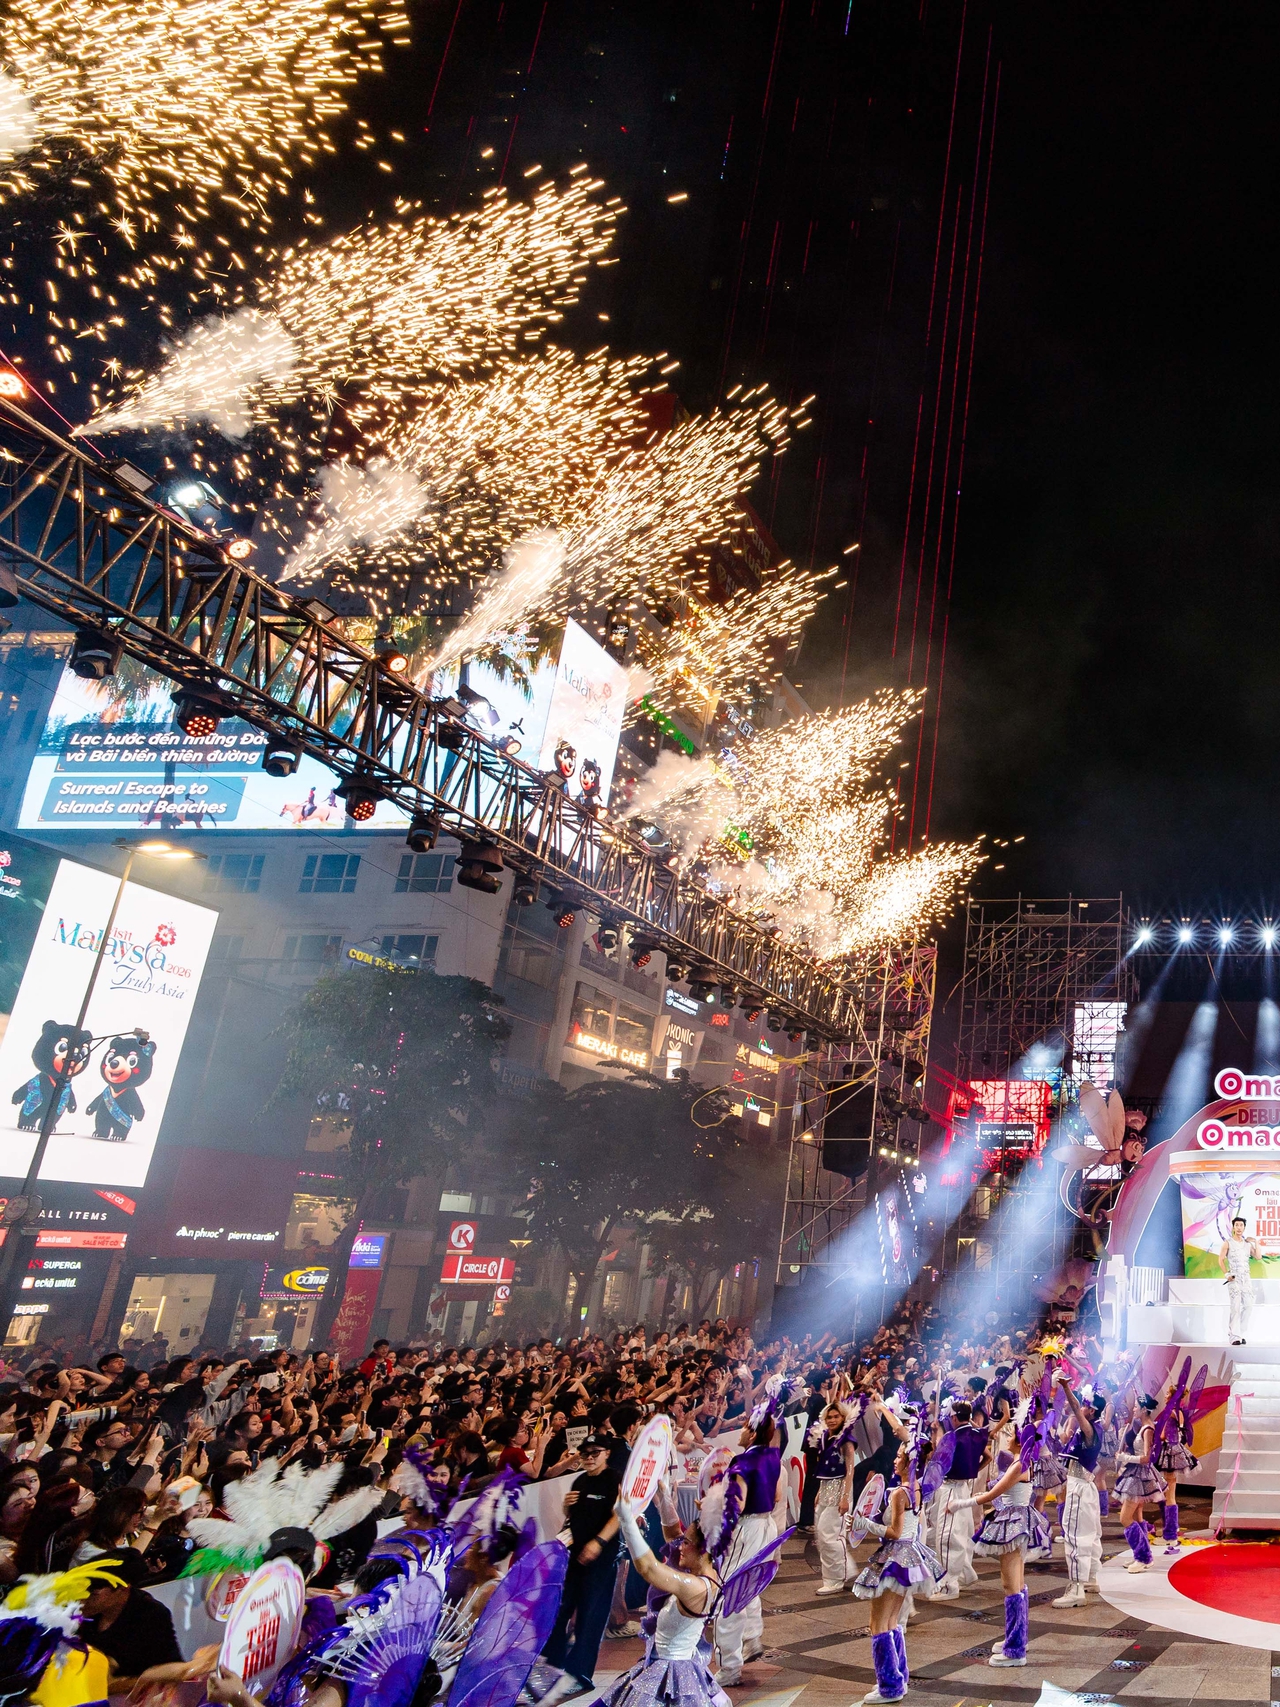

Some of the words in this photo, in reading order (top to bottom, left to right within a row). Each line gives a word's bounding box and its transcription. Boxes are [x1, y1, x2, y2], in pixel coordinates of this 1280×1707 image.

[70, 734, 102, 748] Lạc
[103, 732, 146, 746] bước
[148, 732, 179, 746] đến
[66, 750, 86, 762] và
[88, 750, 118, 762] Bãi
[120, 748, 158, 762] biển
[160, 750, 204, 762] thiên
[206, 749, 261, 765] đường
[60, 782, 122, 795] Surreal
[124, 782, 186, 798] Escape
[189, 782, 208, 795] to
[53, 800, 115, 814] Islands
[117, 800, 154, 814] and
[154, 800, 228, 814] Beaches
[166, 963, 192, 979] 2026
[111, 964, 154, 993] Truly
[156, 981, 186, 1000] Asia
[576, 1032, 618, 1058] MERAKI
[620, 1048, 648, 1068] CAFÉ
[38, 1210, 61, 1219] ALL
[69, 1212, 108, 1221] ITEMS
[228, 1231, 252, 1240] pierre
[43, 1261, 82, 1270] SUPERGA
[463, 1264, 488, 1274] CIRCLE
[14, 1304, 49, 1314] appa
